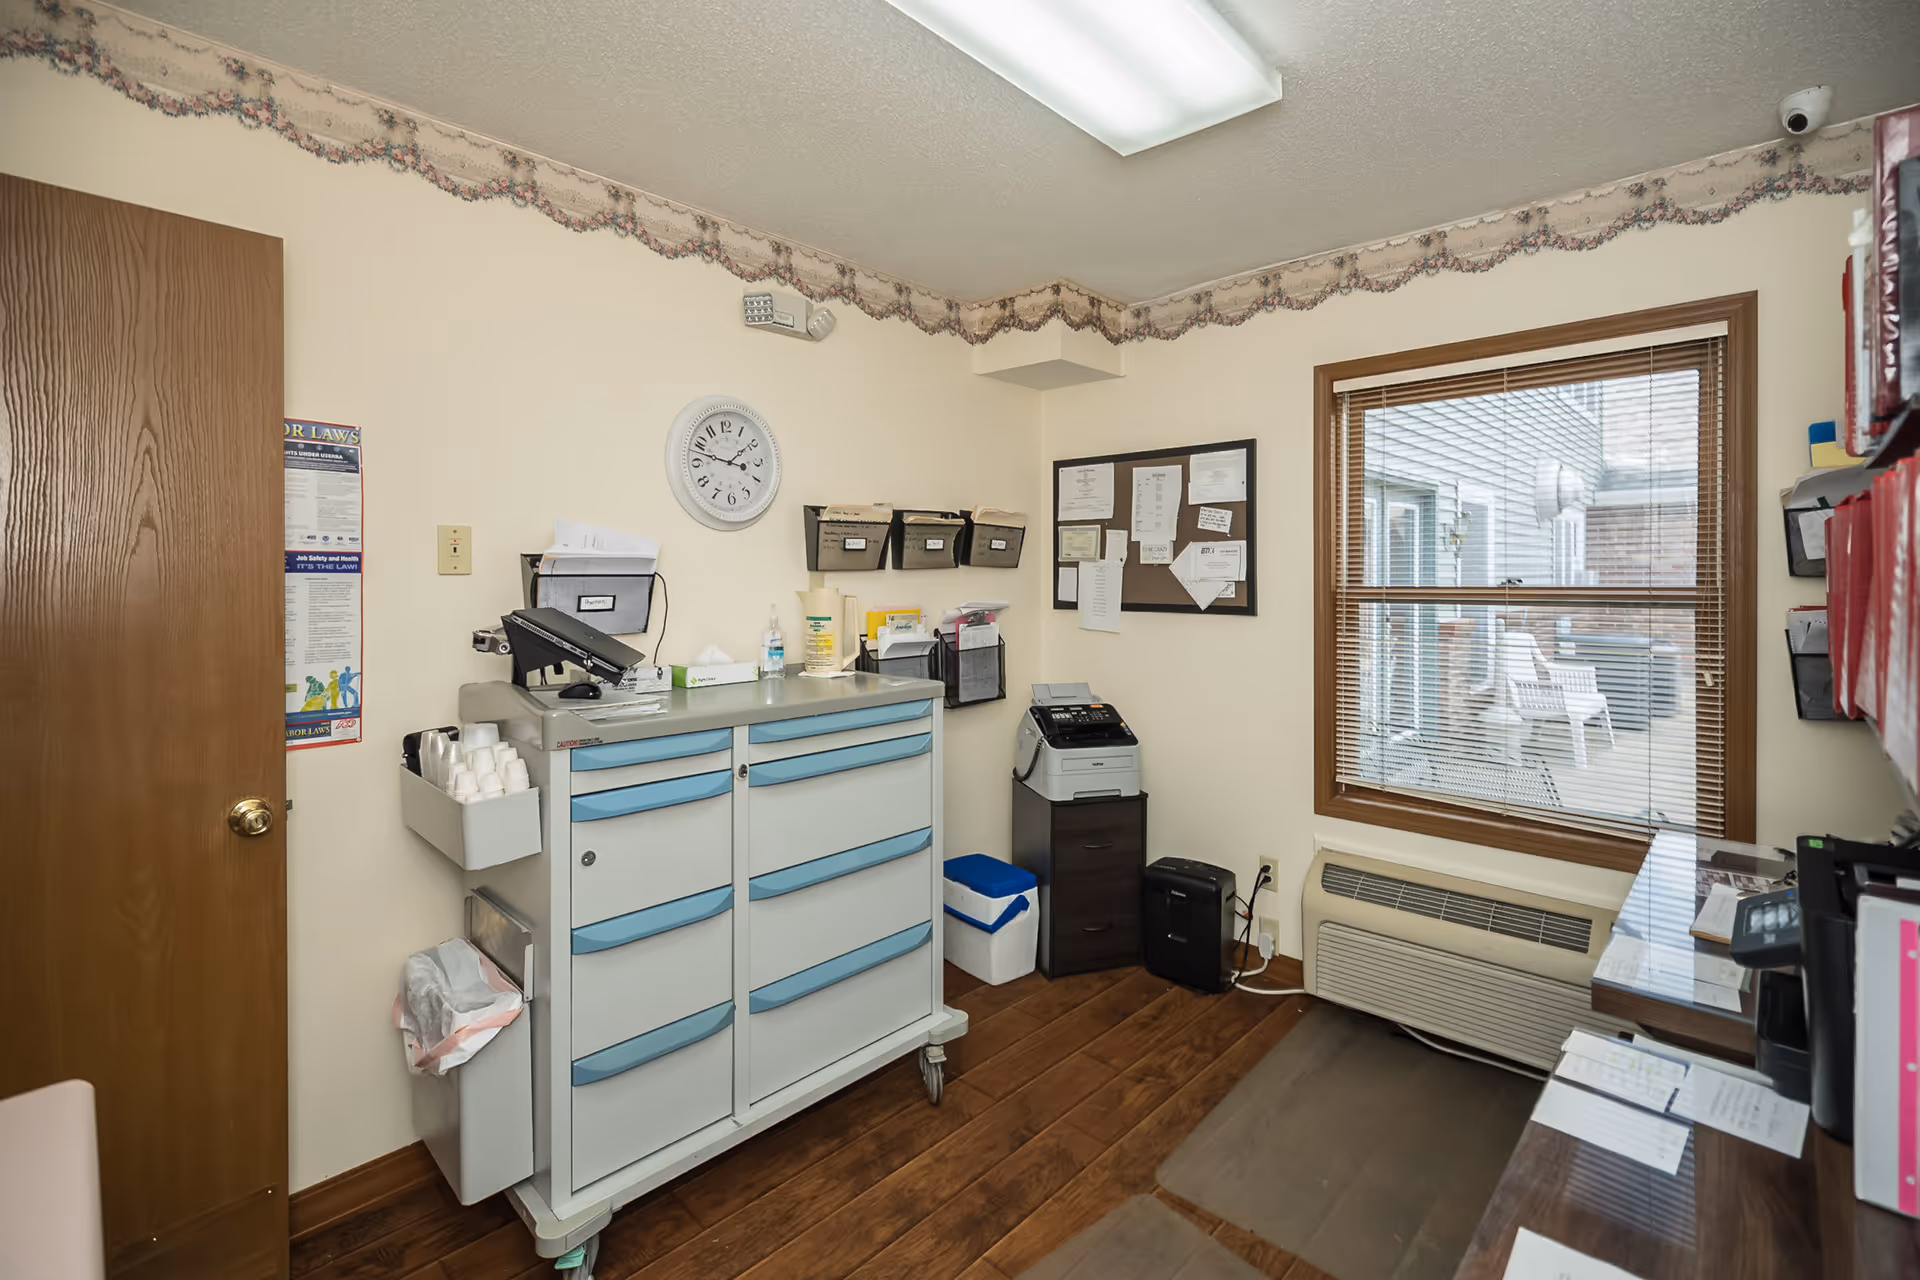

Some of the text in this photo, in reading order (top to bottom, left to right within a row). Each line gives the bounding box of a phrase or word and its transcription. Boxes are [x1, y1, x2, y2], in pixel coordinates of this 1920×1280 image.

[705, 424, 716, 439] 11
[720, 420, 732, 433] 12
[738, 426, 744, 437] 1
[311, 425, 360, 444] LAWS
[695, 436, 707, 451] 10
[747, 438, 759, 451] 2
[299, 450, 320, 458] UNDER
[691, 457, 704, 469] 9
[753, 457, 764, 468] 3
[697, 475, 710, 488] 8
[711, 487, 722, 499] 7
[727, 491, 737, 505] 6
[741, 486, 751, 501] 5
[308, 726, 331, 735] LAWS
